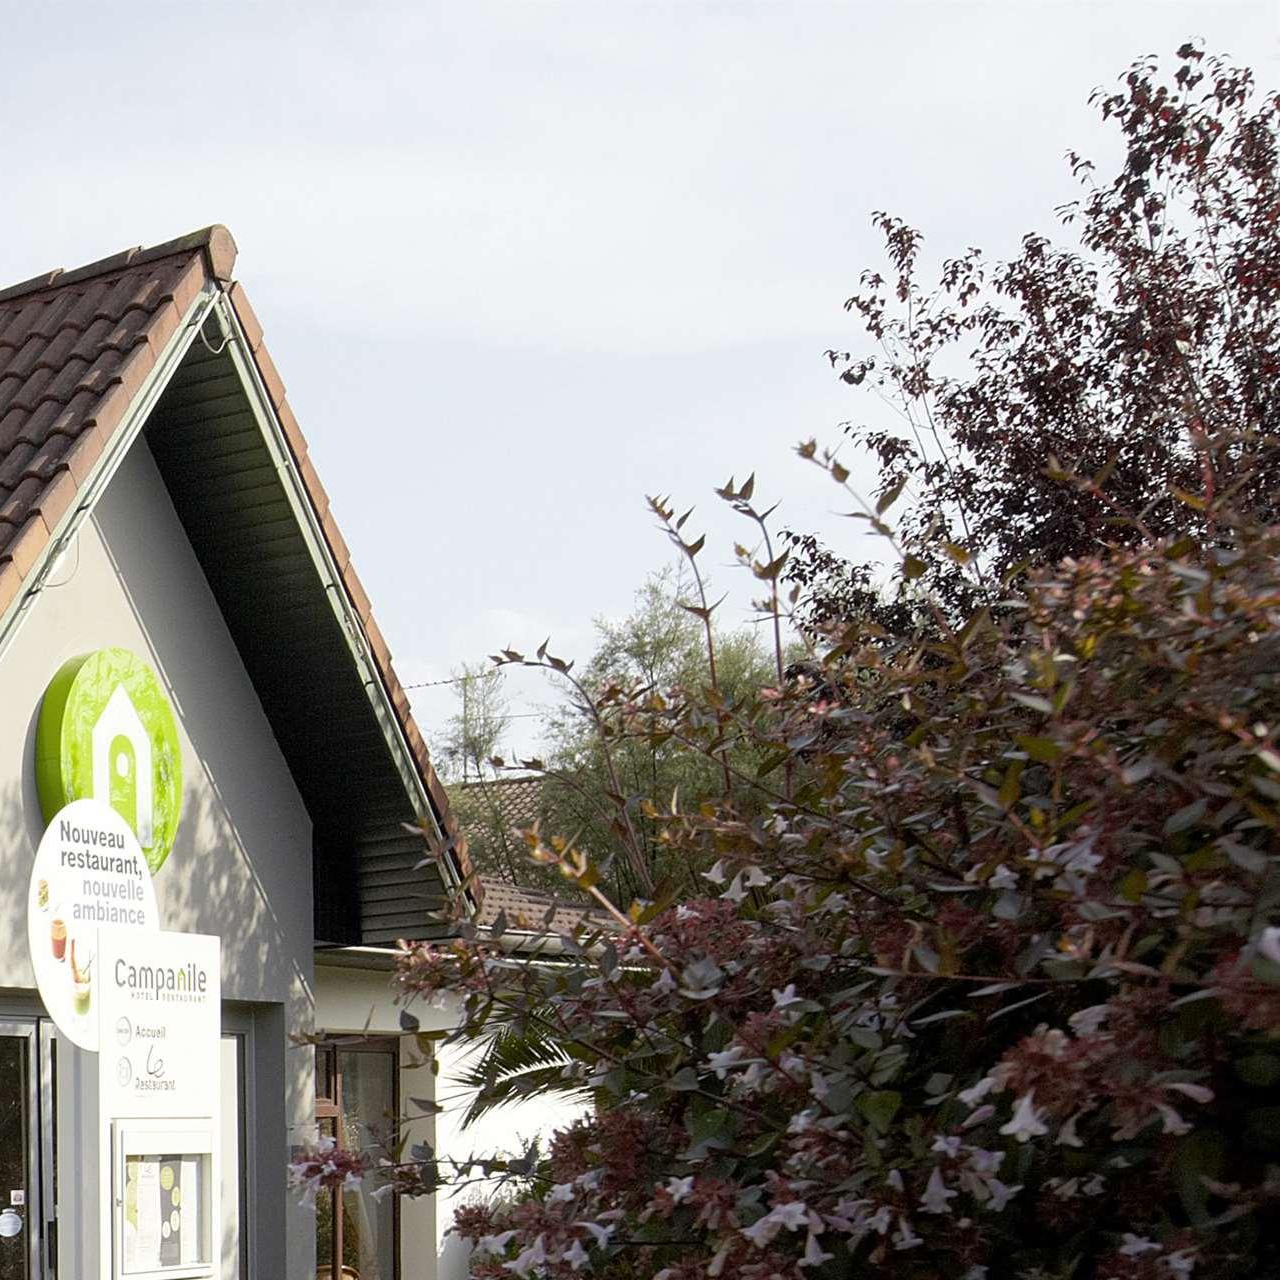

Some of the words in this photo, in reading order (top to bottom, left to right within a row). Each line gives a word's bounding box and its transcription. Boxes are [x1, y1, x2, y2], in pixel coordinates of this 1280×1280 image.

[59, 820, 125, 850] Nouveau
[60, 849, 143, 881] restaurant,
[83, 877, 144, 900] nouvelle
[72, 901, 146, 925] ambiance
[115, 958, 207, 1000] Campanile
[135, 1025, 166, 1040] Accueil
[135, 1076, 176, 1090] Restaurant
